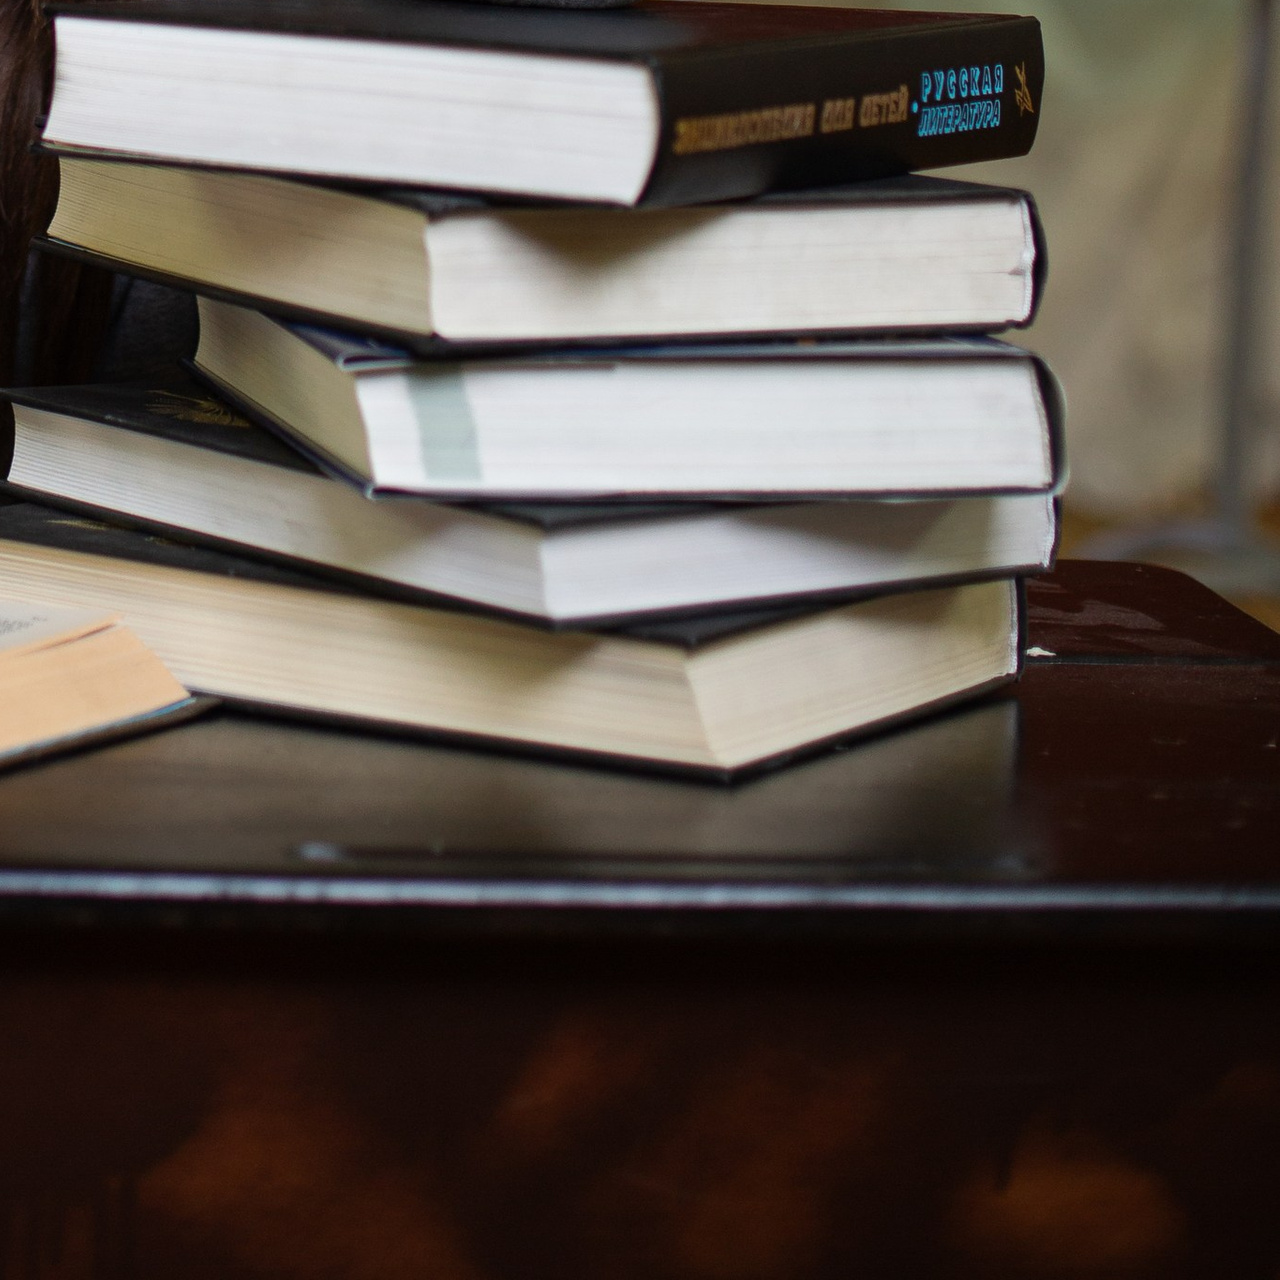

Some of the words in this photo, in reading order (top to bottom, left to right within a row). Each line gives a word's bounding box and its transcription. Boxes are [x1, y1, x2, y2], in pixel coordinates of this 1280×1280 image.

[921, 64, 1004, 102] РУССКАЯ
[859, 84, 909, 127] ДЕТЕЙ
[918, 99, 1001, 137] ЛИТЕРАТУРА
